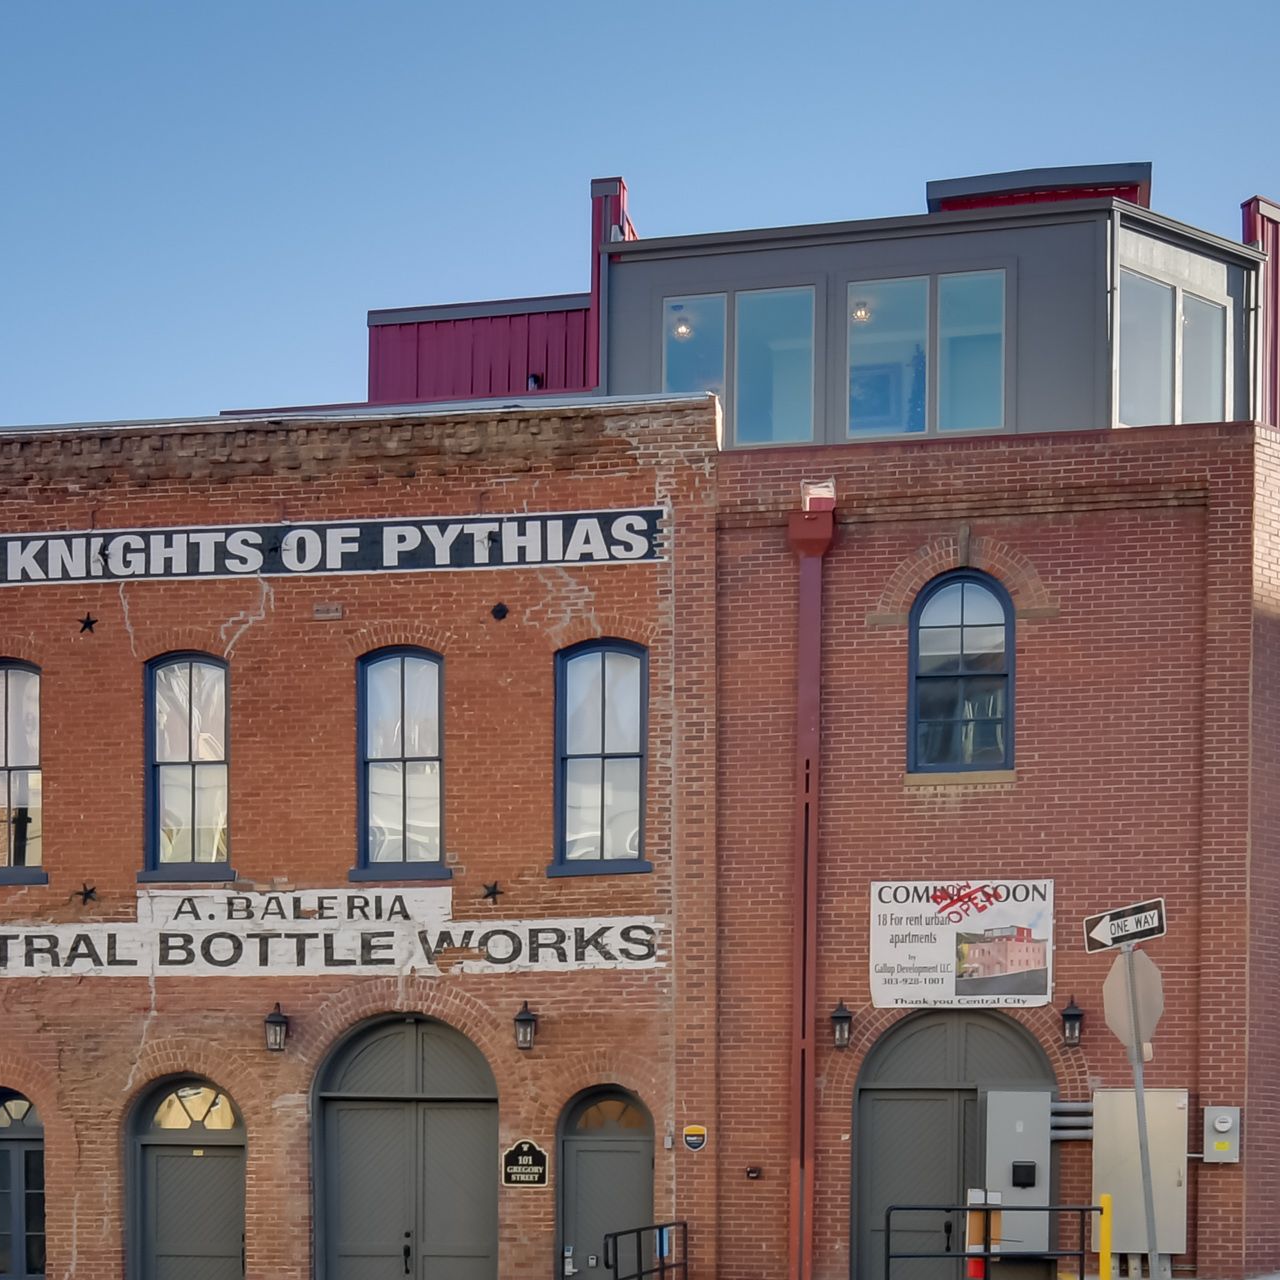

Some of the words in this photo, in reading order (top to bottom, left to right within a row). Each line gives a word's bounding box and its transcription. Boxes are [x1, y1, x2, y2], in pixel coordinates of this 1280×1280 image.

[7, 530, 263, 581] KNIGHTS
[281, 527, 360, 571] OF
[383, 515, 648, 566] PYTHIAS
[980, 884, 1047, 903] SOON
[877, 914, 887, 926] 18
[889, 913, 904, 926] For
[906, 914, 922, 926] rent
[925, 912, 950, 926] urban
[1110, 920, 1129, 935] ONE
[1135, 912, 1155, 929] WAY
[158, 931, 395, 967] BOTTLE
[417, 925, 657, 965] WORKS
[889, 931, 937, 948] apartments
[897, 963, 938, 976] Development
[1004, 997, 1028, 1006] City
[518, 1156, 532, 1165] 101
